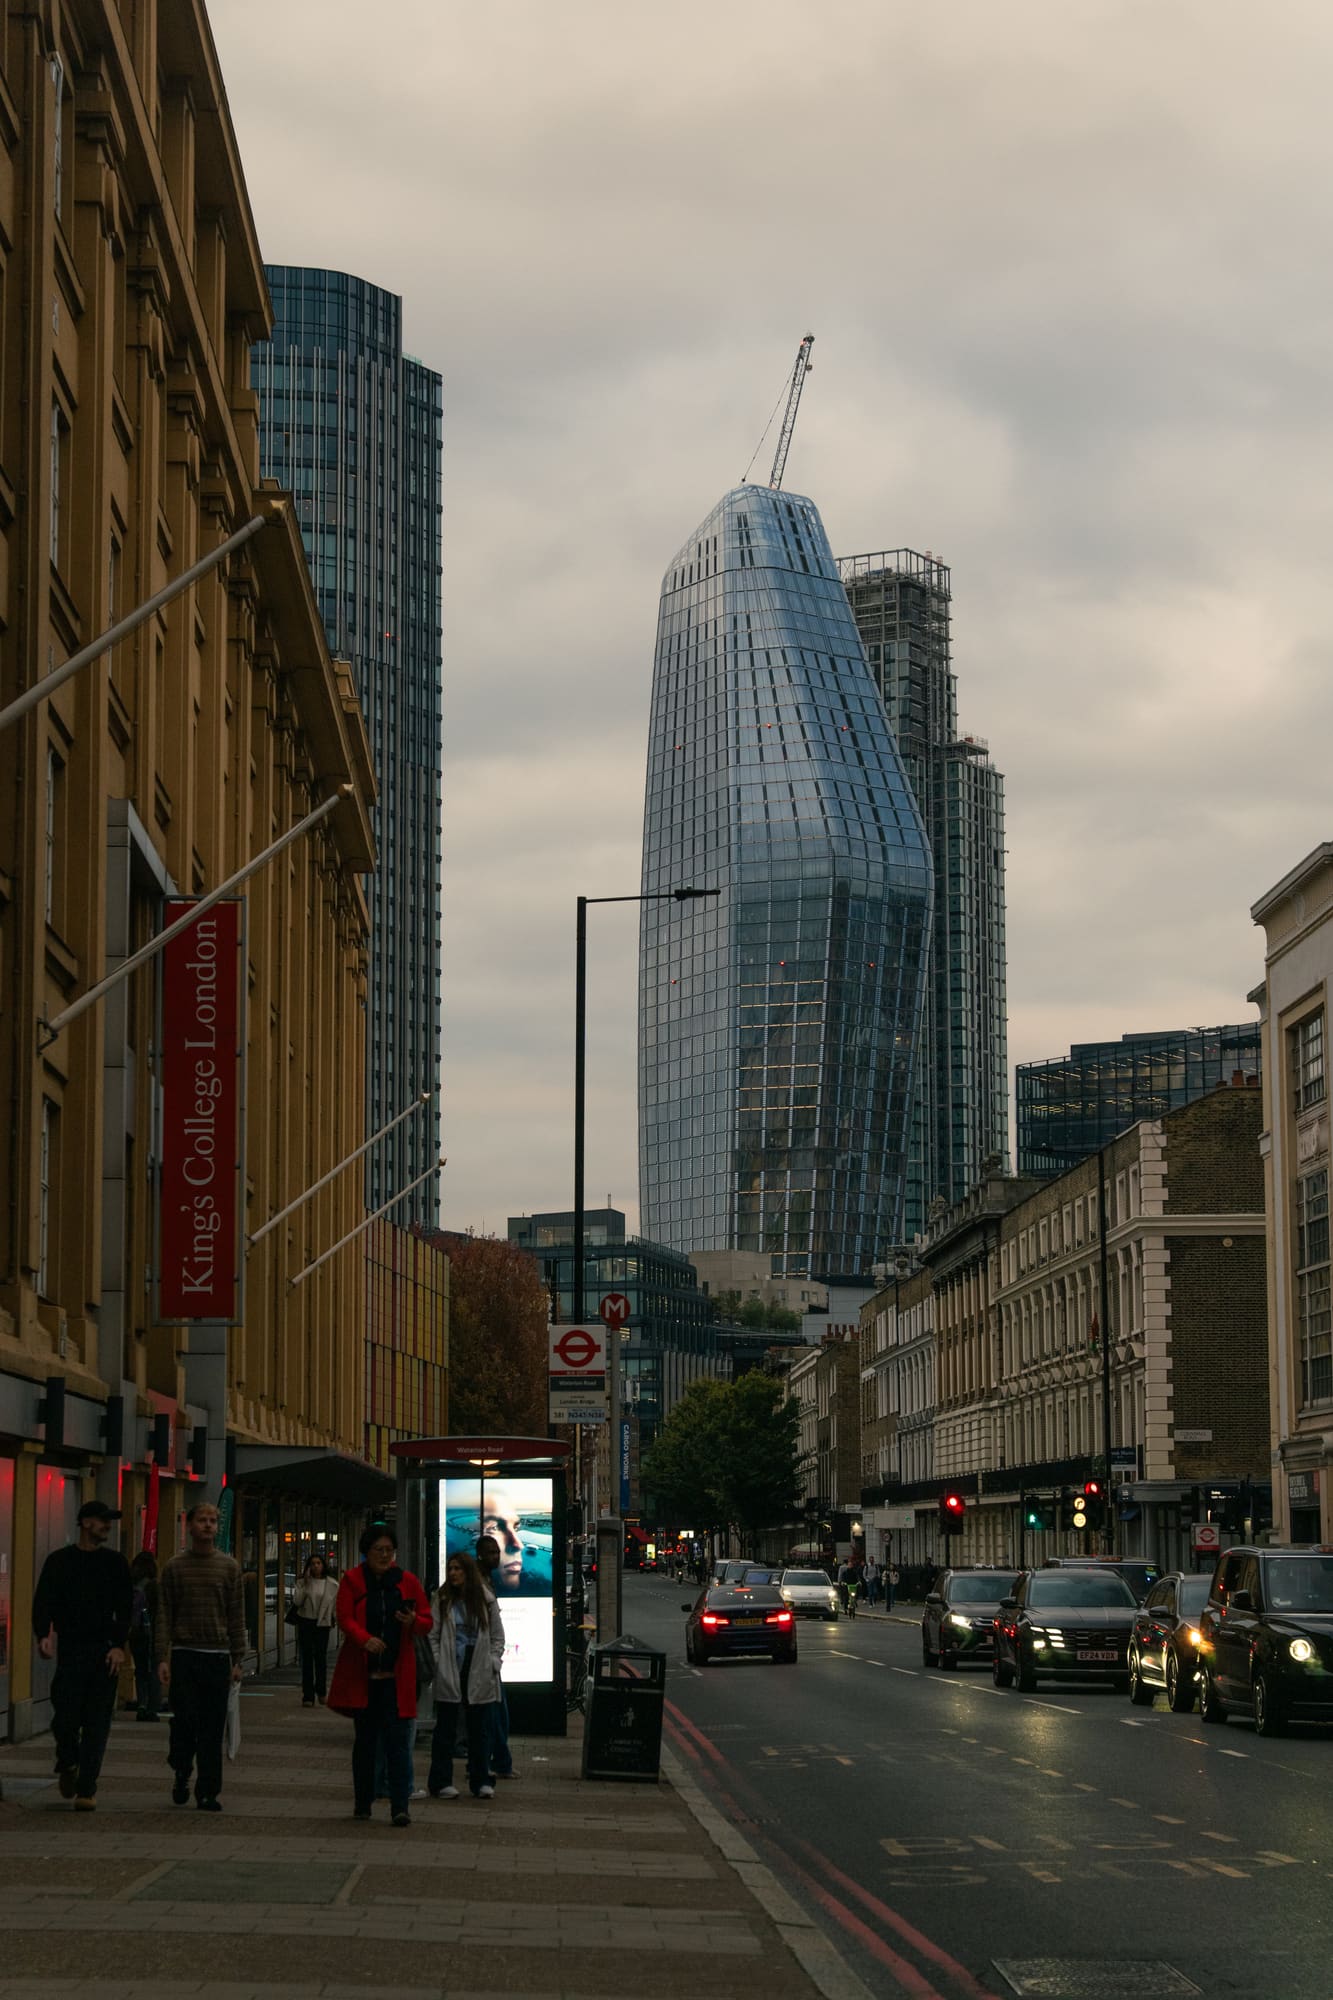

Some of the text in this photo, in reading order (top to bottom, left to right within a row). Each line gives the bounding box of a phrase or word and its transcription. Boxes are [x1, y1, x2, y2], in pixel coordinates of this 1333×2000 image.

[180, 920, 222, 1295] King's College London
[605, 1299, 624, 1318] M
[879, 1832, 1173, 1857] BUS
[881, 1852, 1304, 1888] STOP
